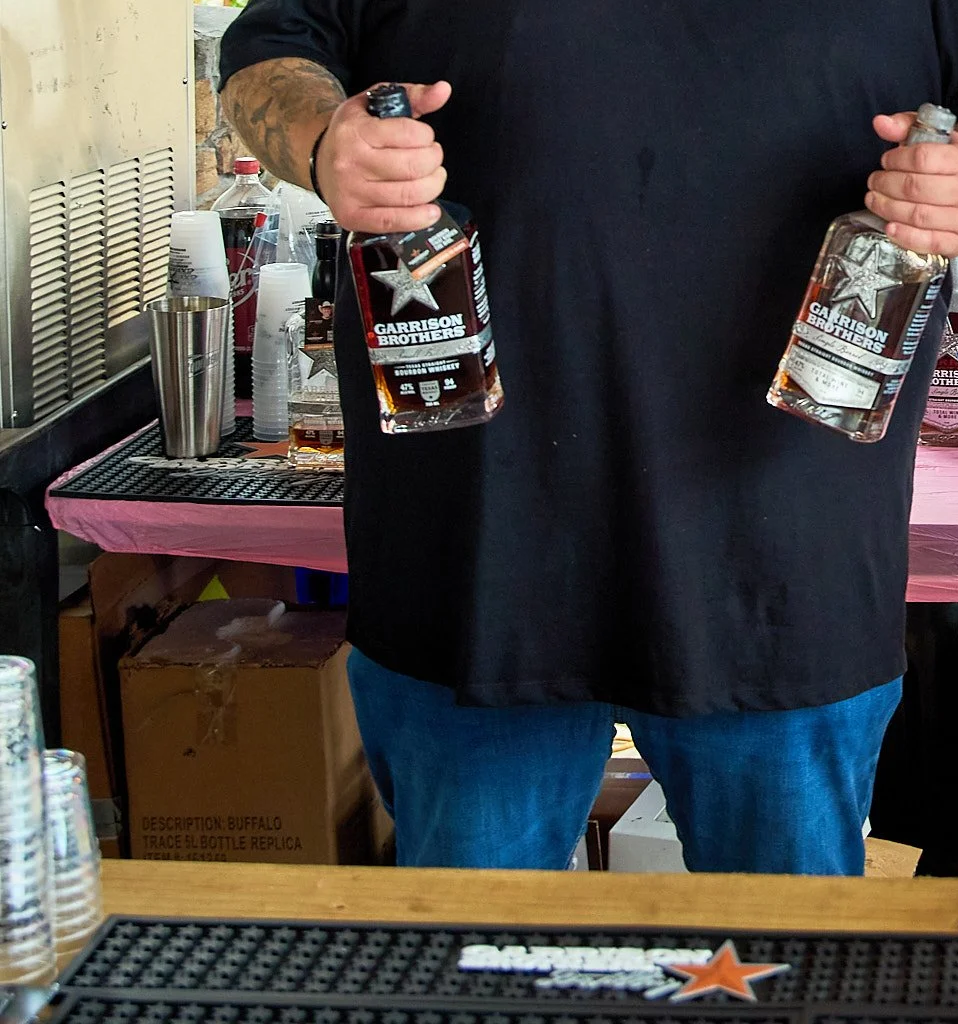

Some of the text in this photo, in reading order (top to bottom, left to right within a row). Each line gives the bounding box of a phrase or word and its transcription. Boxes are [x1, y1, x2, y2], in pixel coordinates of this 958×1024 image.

[374, 313, 463, 335] GARRISON
[809, 302, 889, 343] GARRISON
[378, 325, 466, 346] BROTHERS
[806, 313, 885, 354] BROTHERS
[142, 816, 282, 831] DESCRIPTION: BUFFALO
[143, 835, 182, 849] TRACE
[201, 836, 246, 851] BOTTLE
[251, 837, 303, 851] REPLICA
